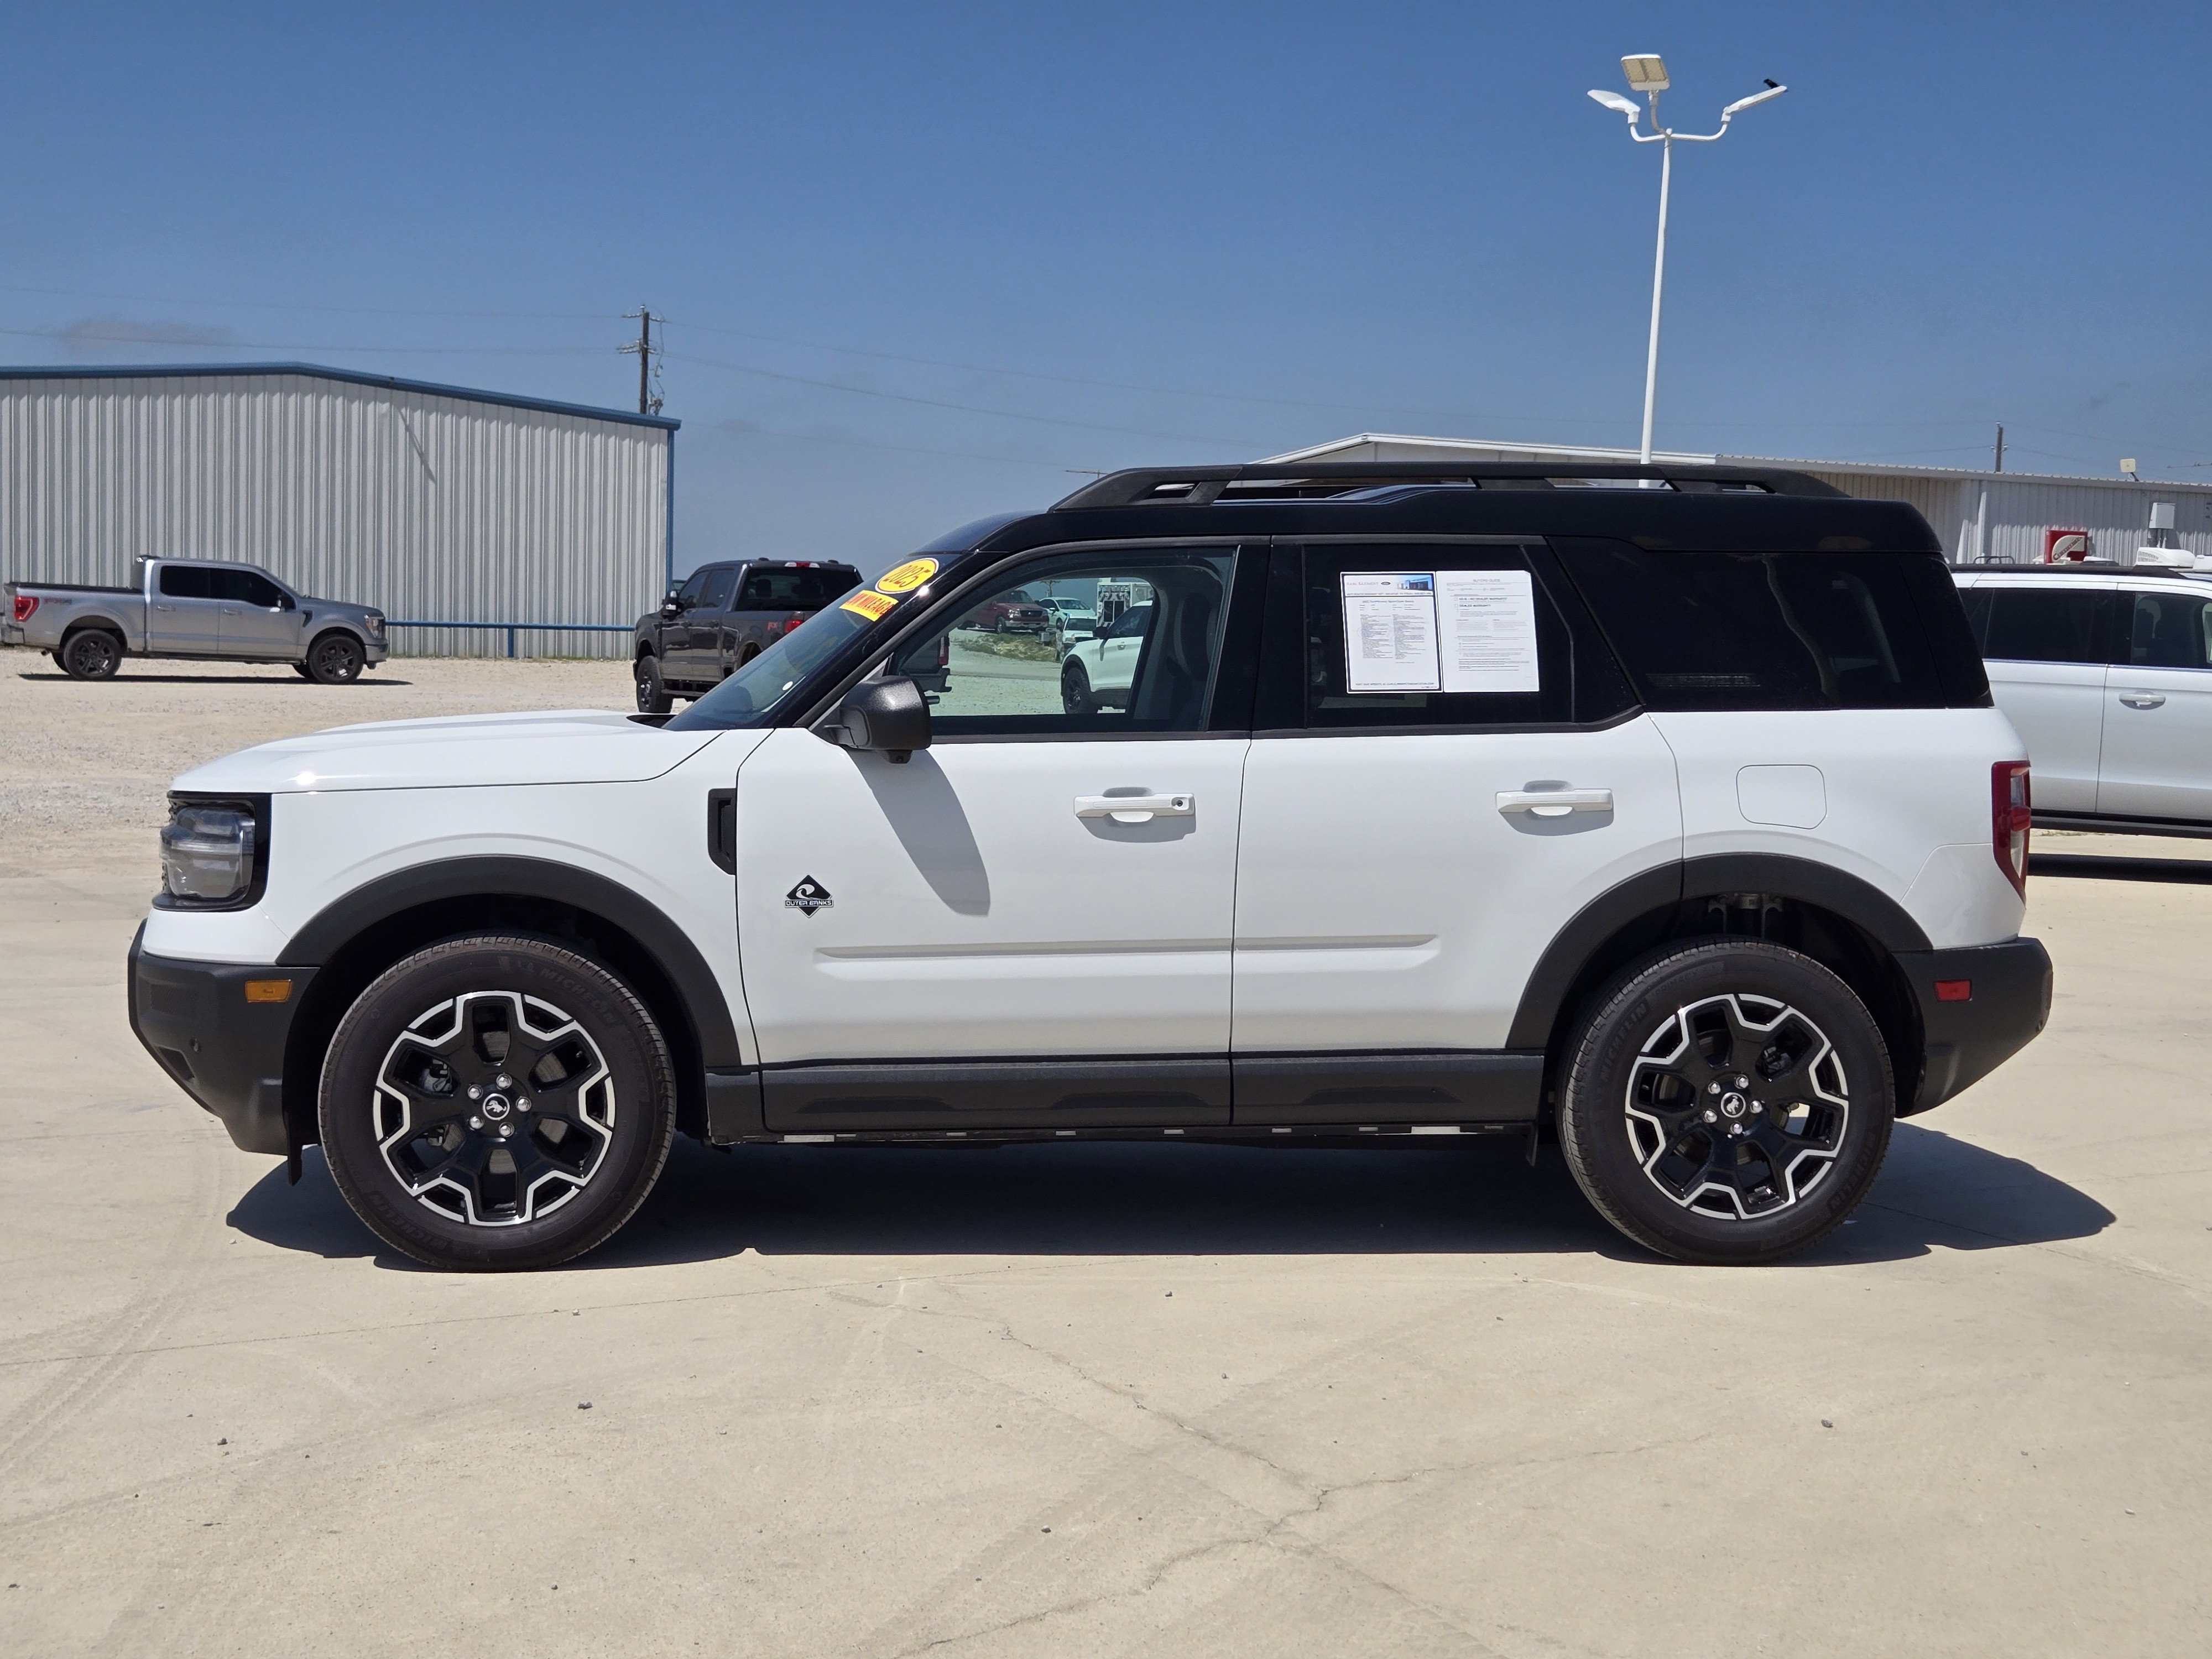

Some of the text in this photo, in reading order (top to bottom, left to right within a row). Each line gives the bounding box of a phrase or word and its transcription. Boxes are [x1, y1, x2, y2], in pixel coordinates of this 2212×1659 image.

[883, 565, 931, 588] 2025
[856, 595, 895, 615] MILEAGE
[1600, 1003, 1647, 1082] MICHELIN
